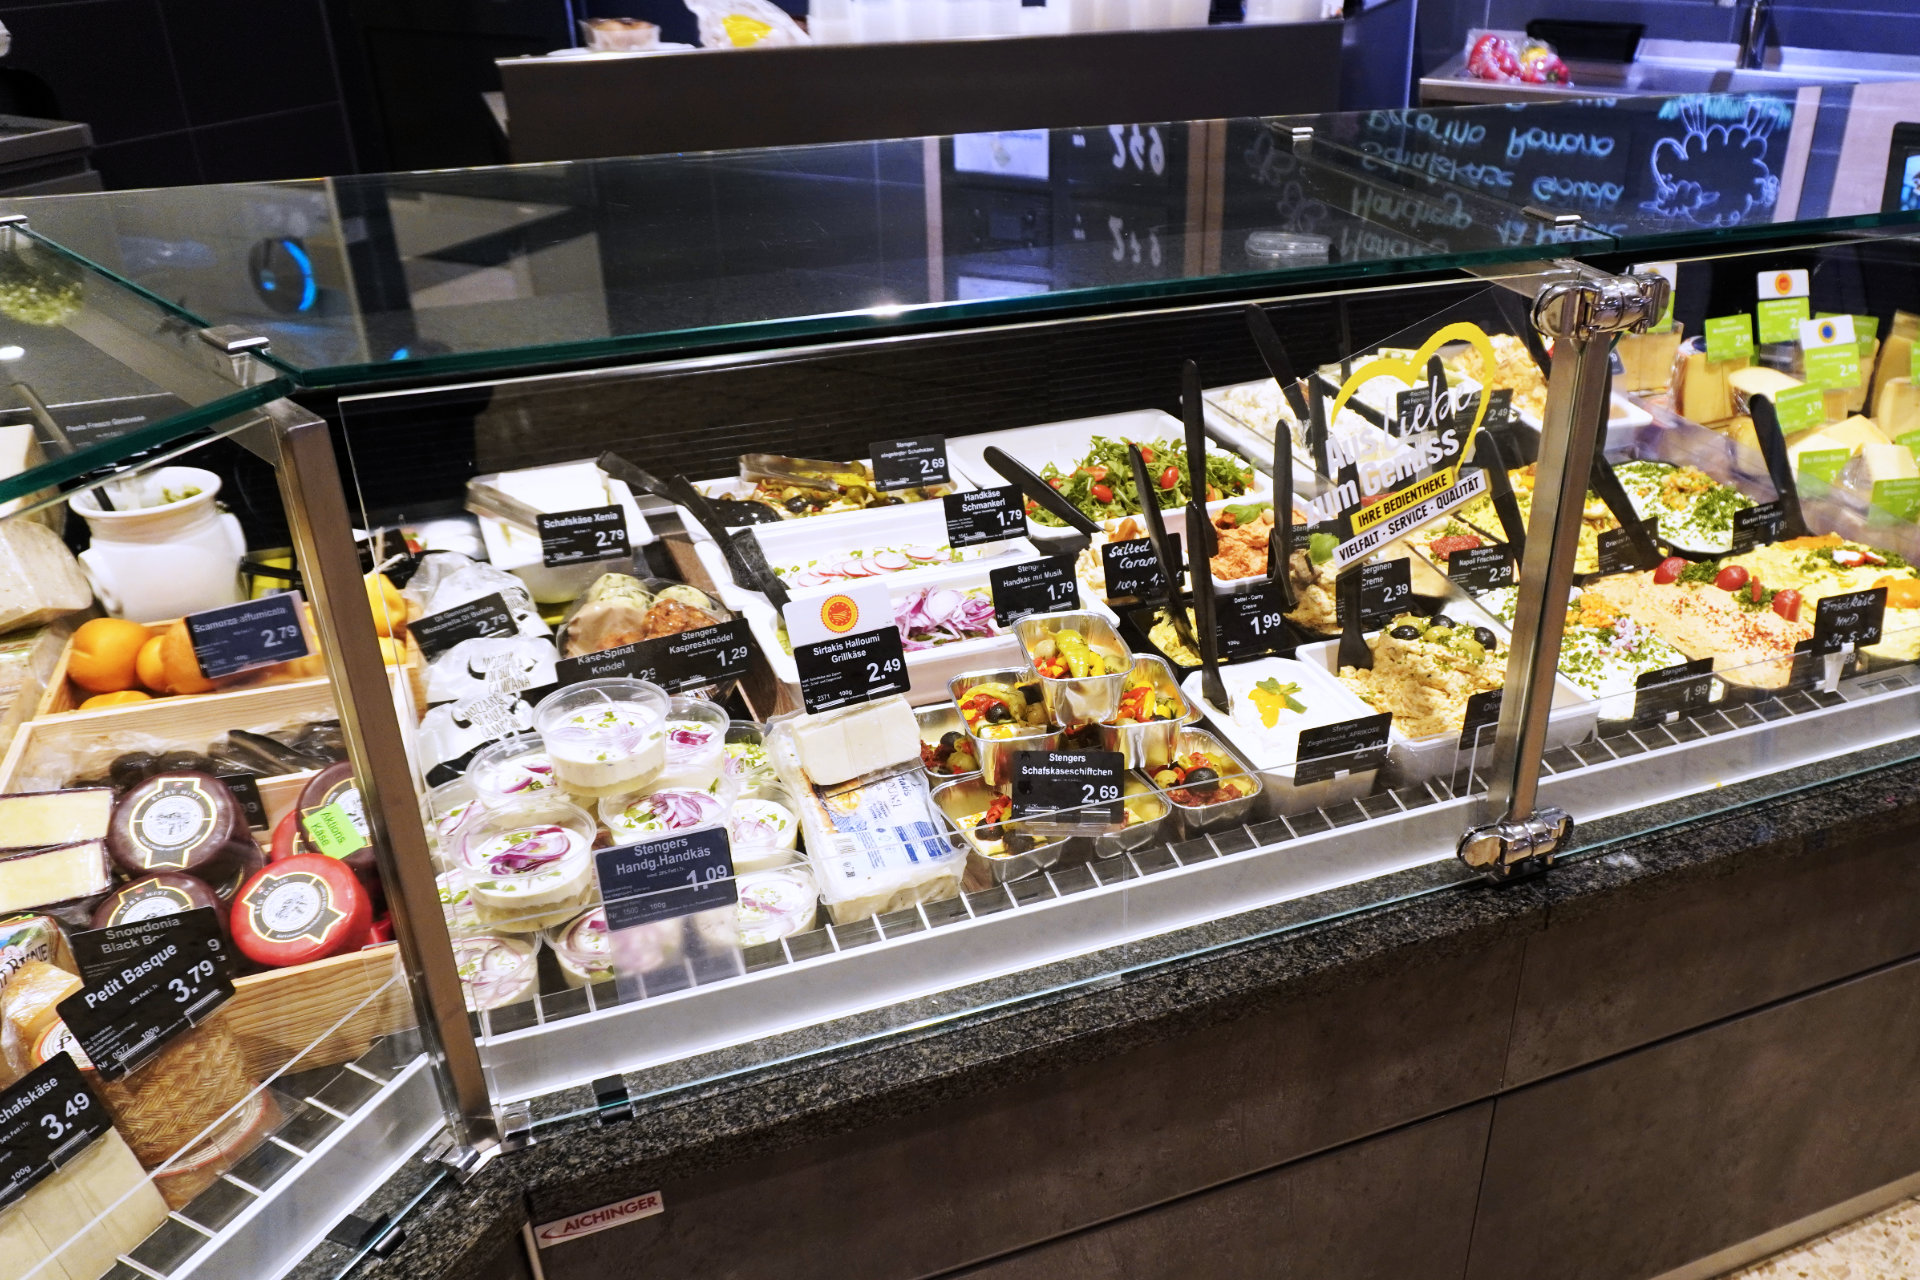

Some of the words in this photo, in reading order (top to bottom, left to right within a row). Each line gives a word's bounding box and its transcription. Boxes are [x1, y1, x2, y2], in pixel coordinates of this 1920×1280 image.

[920, 458, 945, 473] 2.69
[1361, 429, 1460, 497] Genuss
[962, 498, 1006, 512] Schmankerl
[964, 490, 1000, 501] Handkäse
[1358, 509, 1382, 527] IHRE
[1383, 473, 1448, 515] BEDIENTHEKE
[543, 515, 592, 528] Schafskäse
[594, 511, 618, 521] Xenia
[997, 509, 1023, 526] 1.79
[1339, 530, 1380, 560] VIELFALT
[1388, 505, 1429, 535] SERVICE
[1436, 476, 1480, 509] QUALITÄT
[595, 529, 625, 547] 2.79
[1109, 540, 1150, 558] Salted
[1120, 556, 1157, 569] Caram
[1044, 569, 1063, 579] Musik
[1489, 566, 1512, 582] 2.29
[1047, 581, 1074, 600] 1.79
[1384, 583, 1409, 603] 2.39
[193, 617, 238, 633] Scamorza
[476, 613, 508, 635] 2.79
[1250, 613, 1281, 635] 1.99
[260, 625, 298, 648] 2.79
[669, 632, 733, 655] Kaspressknödel
[681, 627, 718, 642] Stengers
[813, 642, 844, 656] Sirtakis
[845, 633, 880, 648] Halloumi
[716, 646, 748, 667] 1.29
[831, 650, 867, 663] Grillkäse
[866, 658, 901, 683] 2.49
[1683, 684, 1708, 702] 1.99
[1049, 753, 1086, 763] Stengers
[1081, 784, 1119, 804] 2.69
[634, 839, 688, 856] Stengers
[616, 847, 711, 875] Handg.Handkäs
[686, 865, 728, 892] 1.09
[105, 917, 182, 940] Snowdonia
[101, 938, 140, 954] Black
[84, 978, 124, 1009] Petit
[121, 943, 178, 985] Basque
[168, 959, 215, 1003] 3.79
[0, 1076, 58, 1125] chafskäse
[40, 1092, 90, 1140] 3.49
[10, 1164, 31, 1182] 100g
[564, 1196, 658, 1233] AICHINGER
